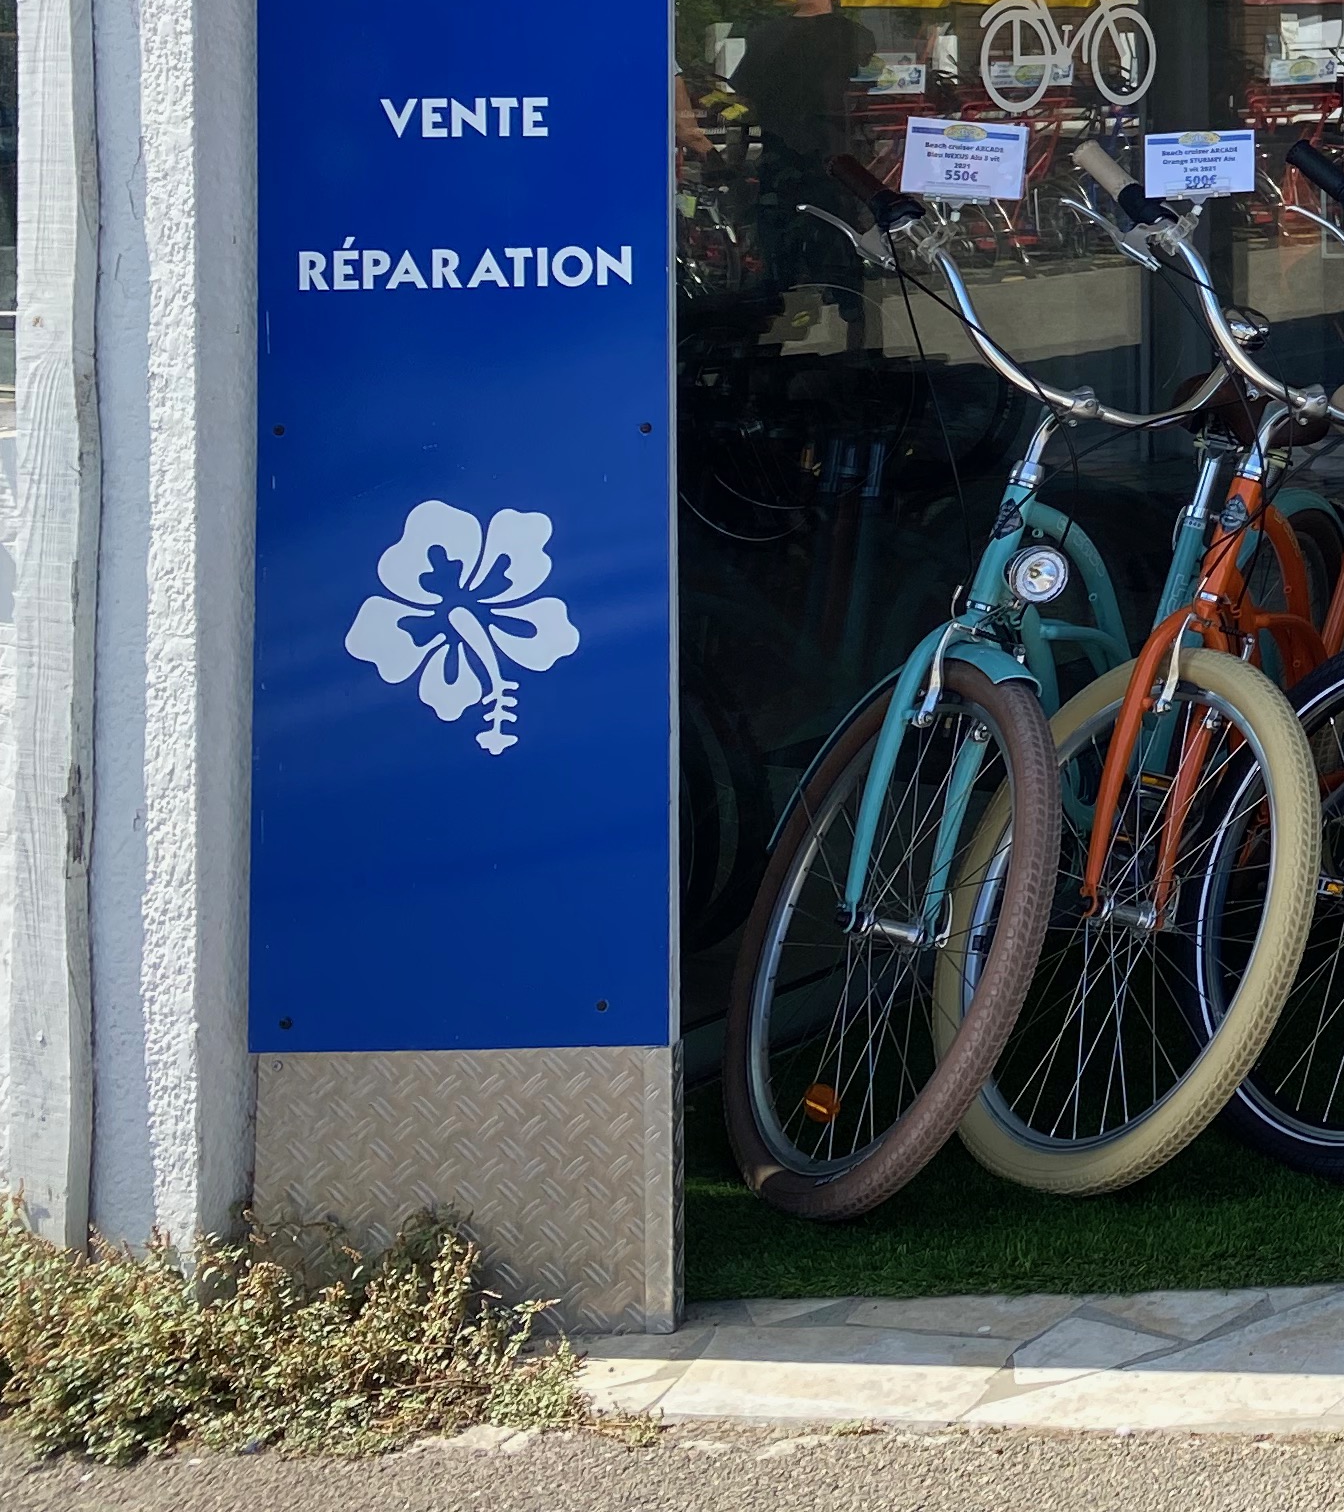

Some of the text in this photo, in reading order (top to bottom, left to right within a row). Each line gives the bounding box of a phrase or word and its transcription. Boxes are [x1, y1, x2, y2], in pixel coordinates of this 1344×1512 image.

[380, 97, 549, 138] VENTE
[925, 142, 947, 150] Beach
[975, 145, 1004, 153] ARCADE
[944, 170, 979, 182] 550€
[1185, 175, 1217, 185] 500€
[299, 237, 633, 291] RÉPARATION
